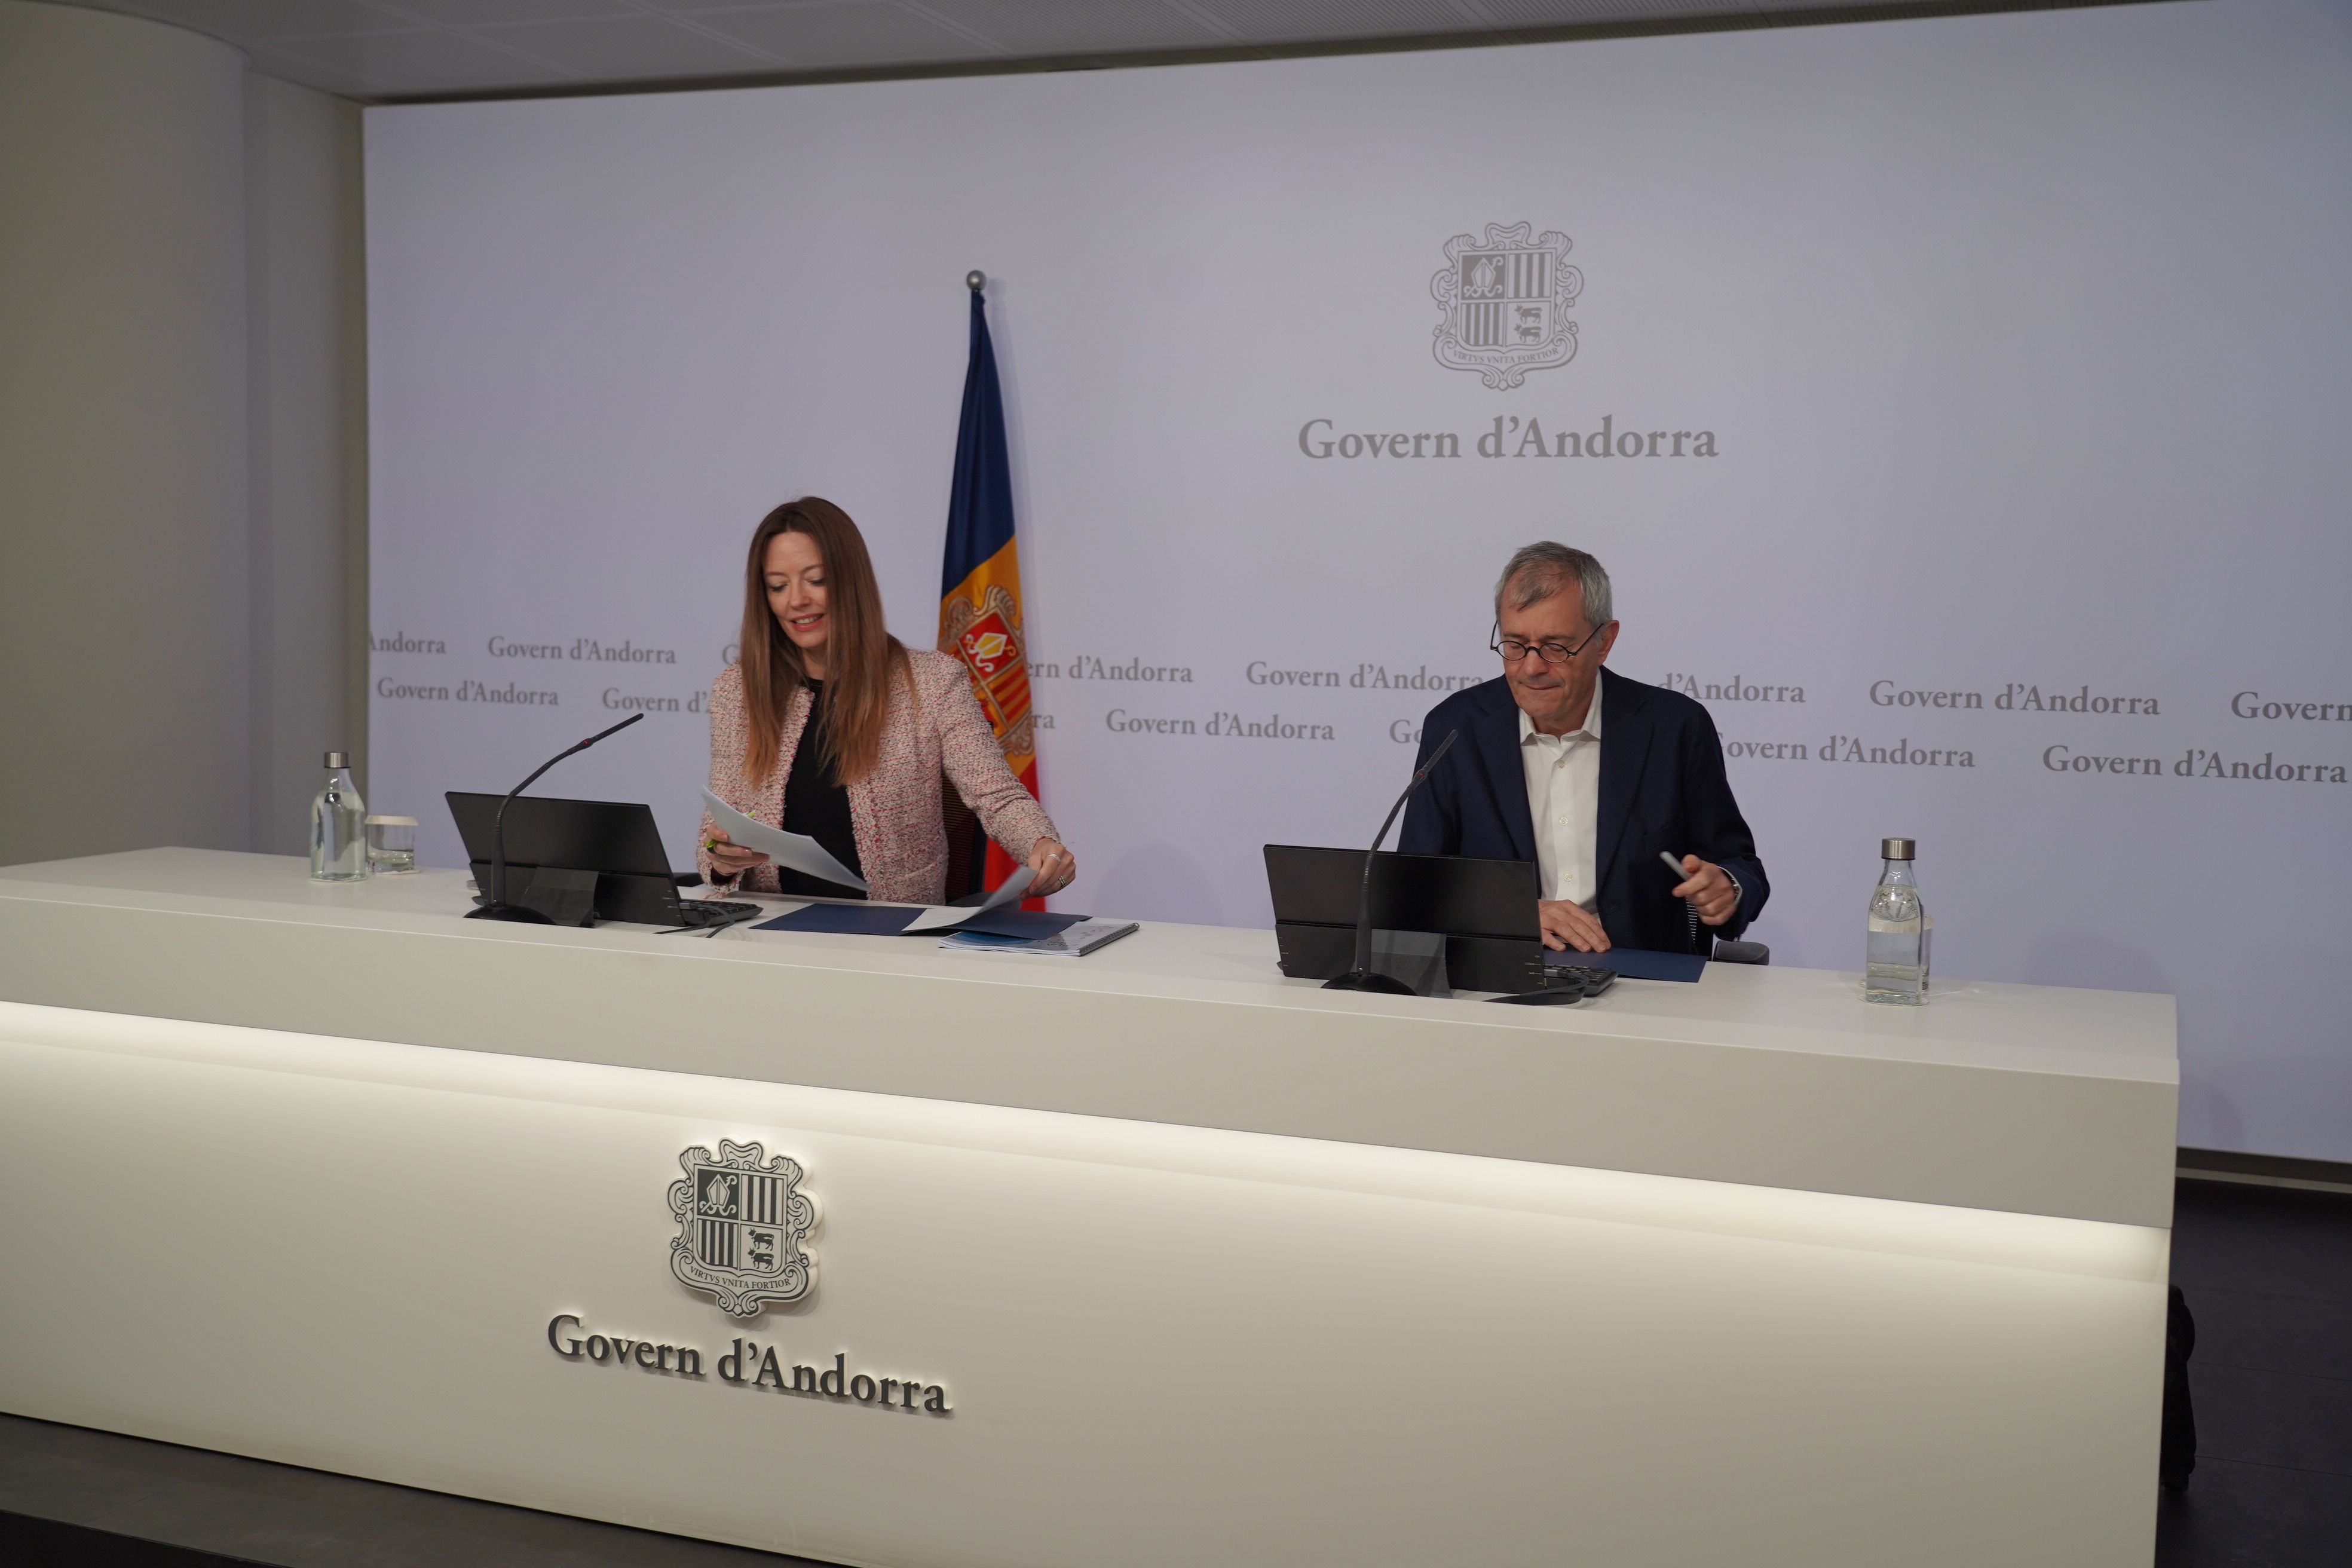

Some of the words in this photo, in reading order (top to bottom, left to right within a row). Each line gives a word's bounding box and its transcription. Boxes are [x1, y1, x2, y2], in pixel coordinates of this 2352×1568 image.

[1298, 418, 1462, 460] Govern
[1476, 414, 1720, 459] d’Andorra
[487, 635, 563, 660] Govern
[569, 638, 676, 664] d’Andorra
[1068, 656, 1193, 684] d’Andorra
[1245, 661, 1341, 688] Govern
[376, 676, 449, 702] Govern
[455, 679, 559, 706] d’Andorra
[601, 687, 680, 712] Govern
[1869, 679, 1984, 710] Govern
[1994, 682, 2161, 716] d’Andorra
[2231, 691, 2352, 722] Govern
[1105, 708, 1196, 736] Govern
[1204, 711, 1336, 741] d’Andorra
[1718, 732, 1808, 761] overn
[1818, 734, 1976, 768] d’Andorra
[2042, 744, 2163, 776] Govern
[2173, 749, 2348, 784] d’Andorra
[690, 1264, 720, 1284] VIRTVS
[722, 1276, 749, 1289] VNITA
[751, 1277, 791, 1290] FORTIOR
[547, 1313, 707, 1377] Govern
[716, 1337, 954, 1414] d’Andorra
